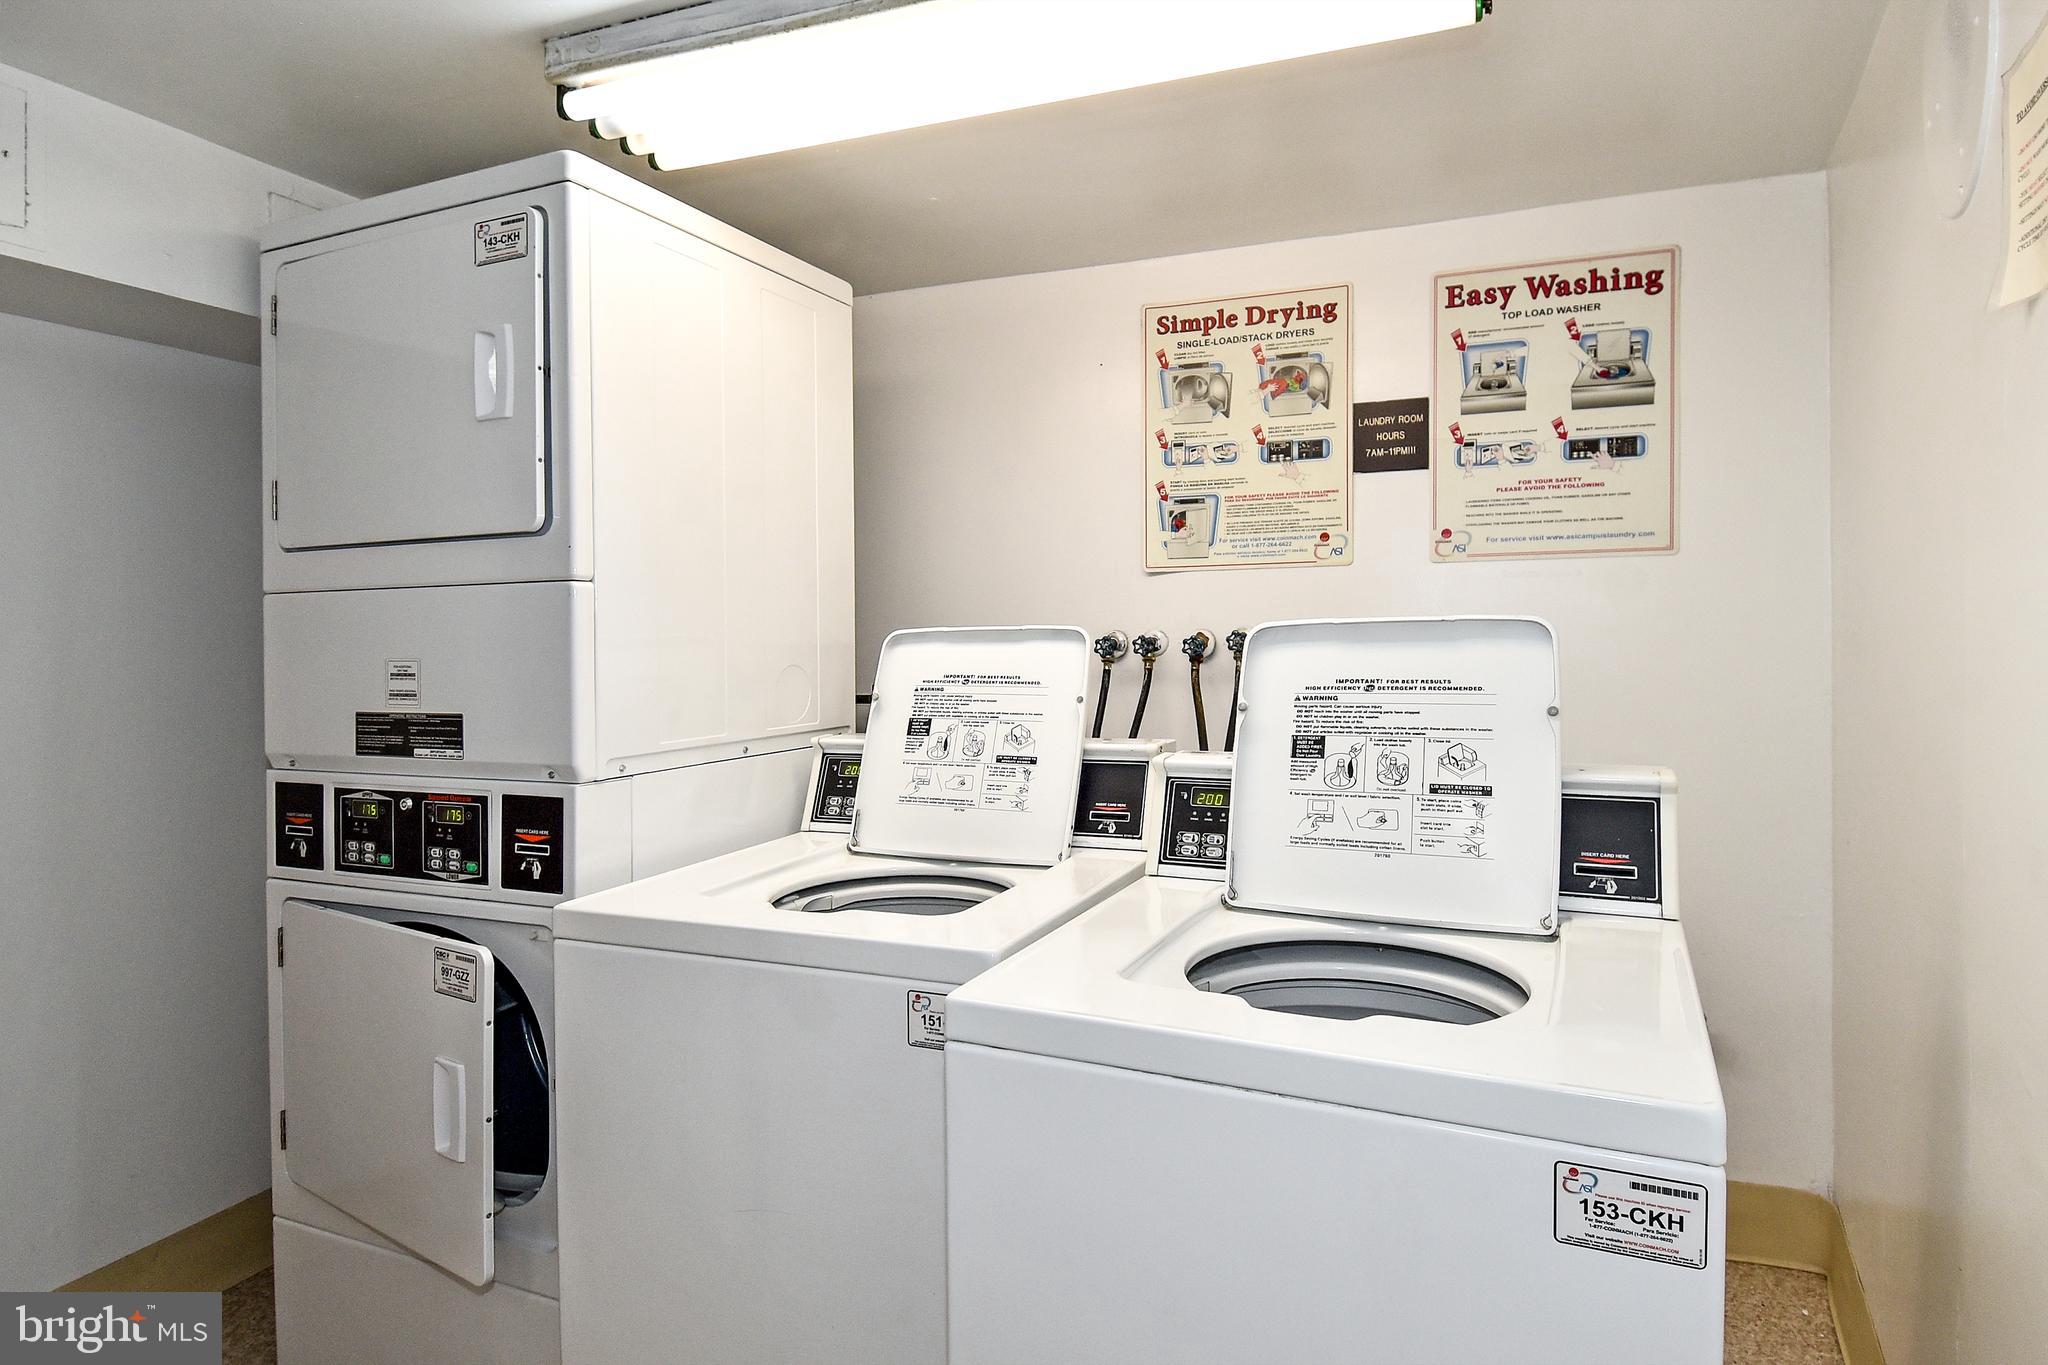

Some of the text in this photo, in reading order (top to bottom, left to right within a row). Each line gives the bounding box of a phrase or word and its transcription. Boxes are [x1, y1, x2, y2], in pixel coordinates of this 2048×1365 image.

[483, 231, 520, 247] 143-CKH
[1445, 267, 1665, 310] Easy Washing
[1502, 302, 1601, 320] TOP LOAD WASHER
[1156, 301, 1338, 336] Simple Drying
[1177, 332, 1273, 350] SINGLE-LOAD/STACK
[1276, 328, 1315, 339] DRYERS
[1359, 414, 1424, 427] LAUNDRY ROOM
[1376, 431, 1405, 441] HOURS
[1197, 793, 1223, 805] 200
[362, 804, 376, 816] 175
[446, 809, 462, 821] 175
[1579, 1198, 1684, 1233] 153-CKH
[1595, 1219, 1616, 1227] Service:
